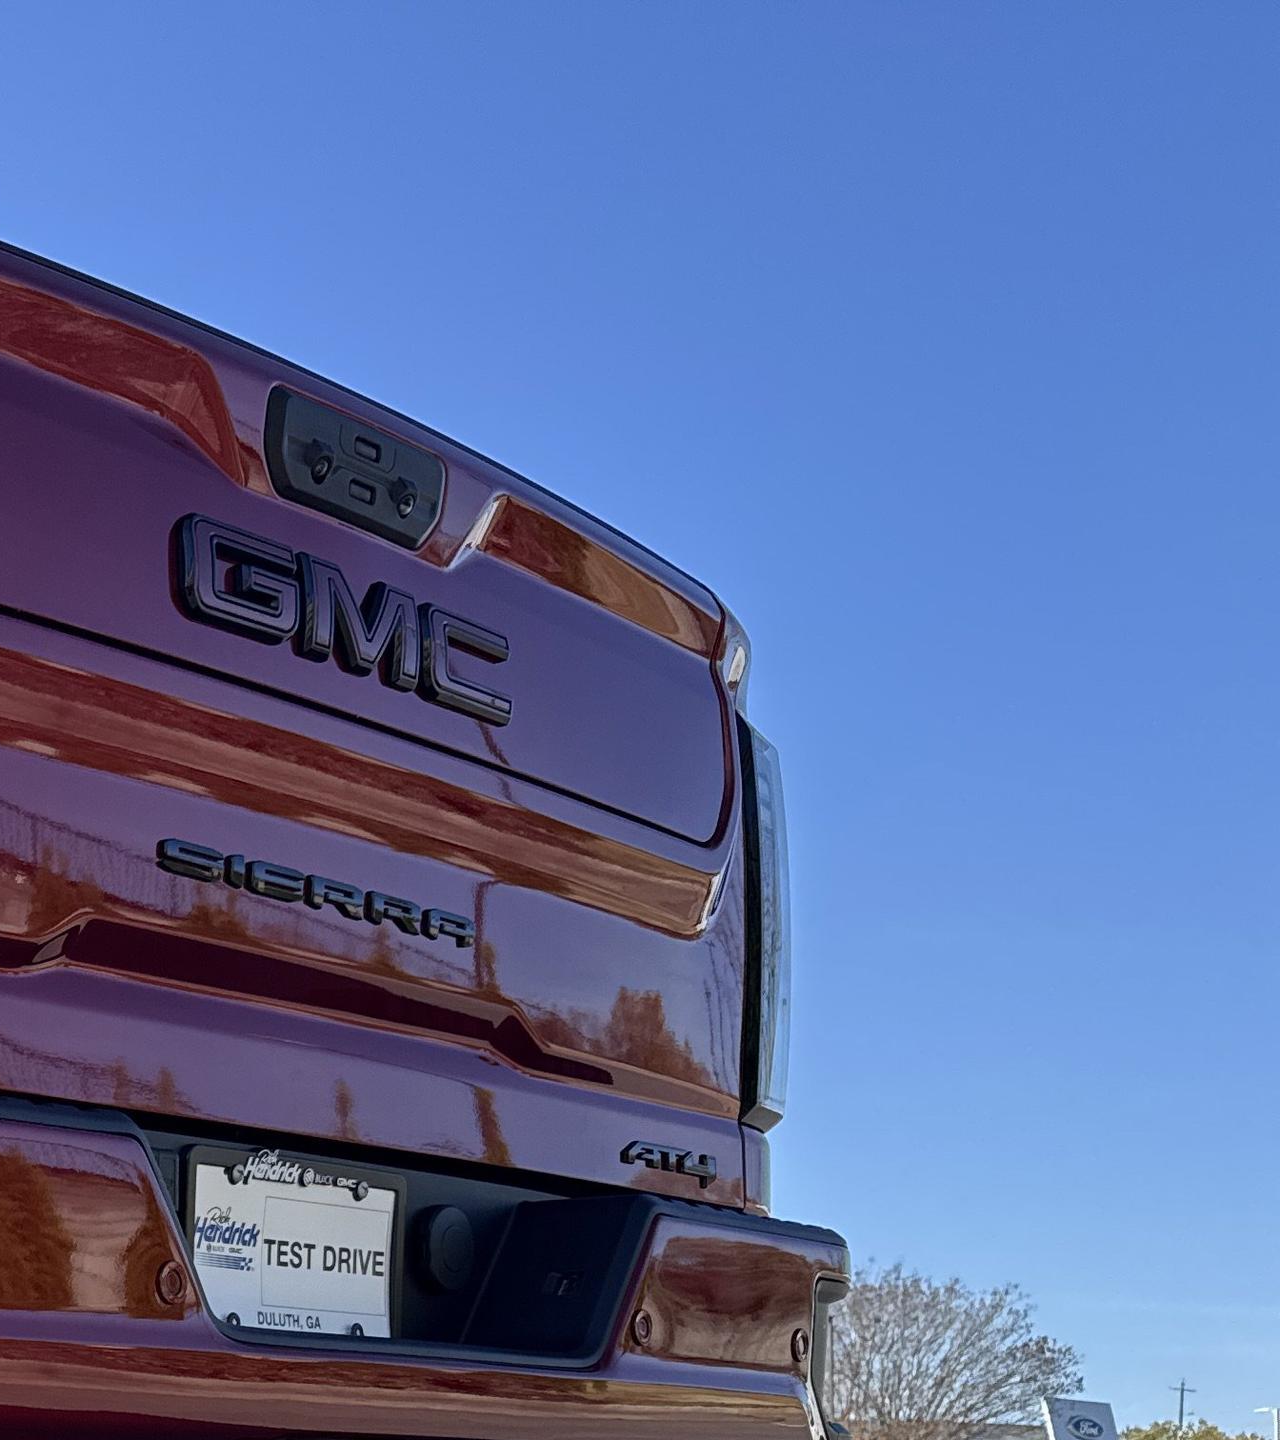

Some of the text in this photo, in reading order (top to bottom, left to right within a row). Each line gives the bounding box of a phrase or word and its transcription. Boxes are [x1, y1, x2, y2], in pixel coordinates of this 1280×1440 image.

[170, 512, 513, 728] GMC
[155, 838, 476, 949] SIERRA
[243, 1156, 301, 1184] Hendrick
[620, 1140, 716, 1189] AT4
[195, 1216, 260, 1248] Hendrick
[263, 1238, 385, 1277] TEST DRIVE
[257, 1311, 322, 1330] DULUTH, GA
[1079, 1421, 1100, 1438] Ford
